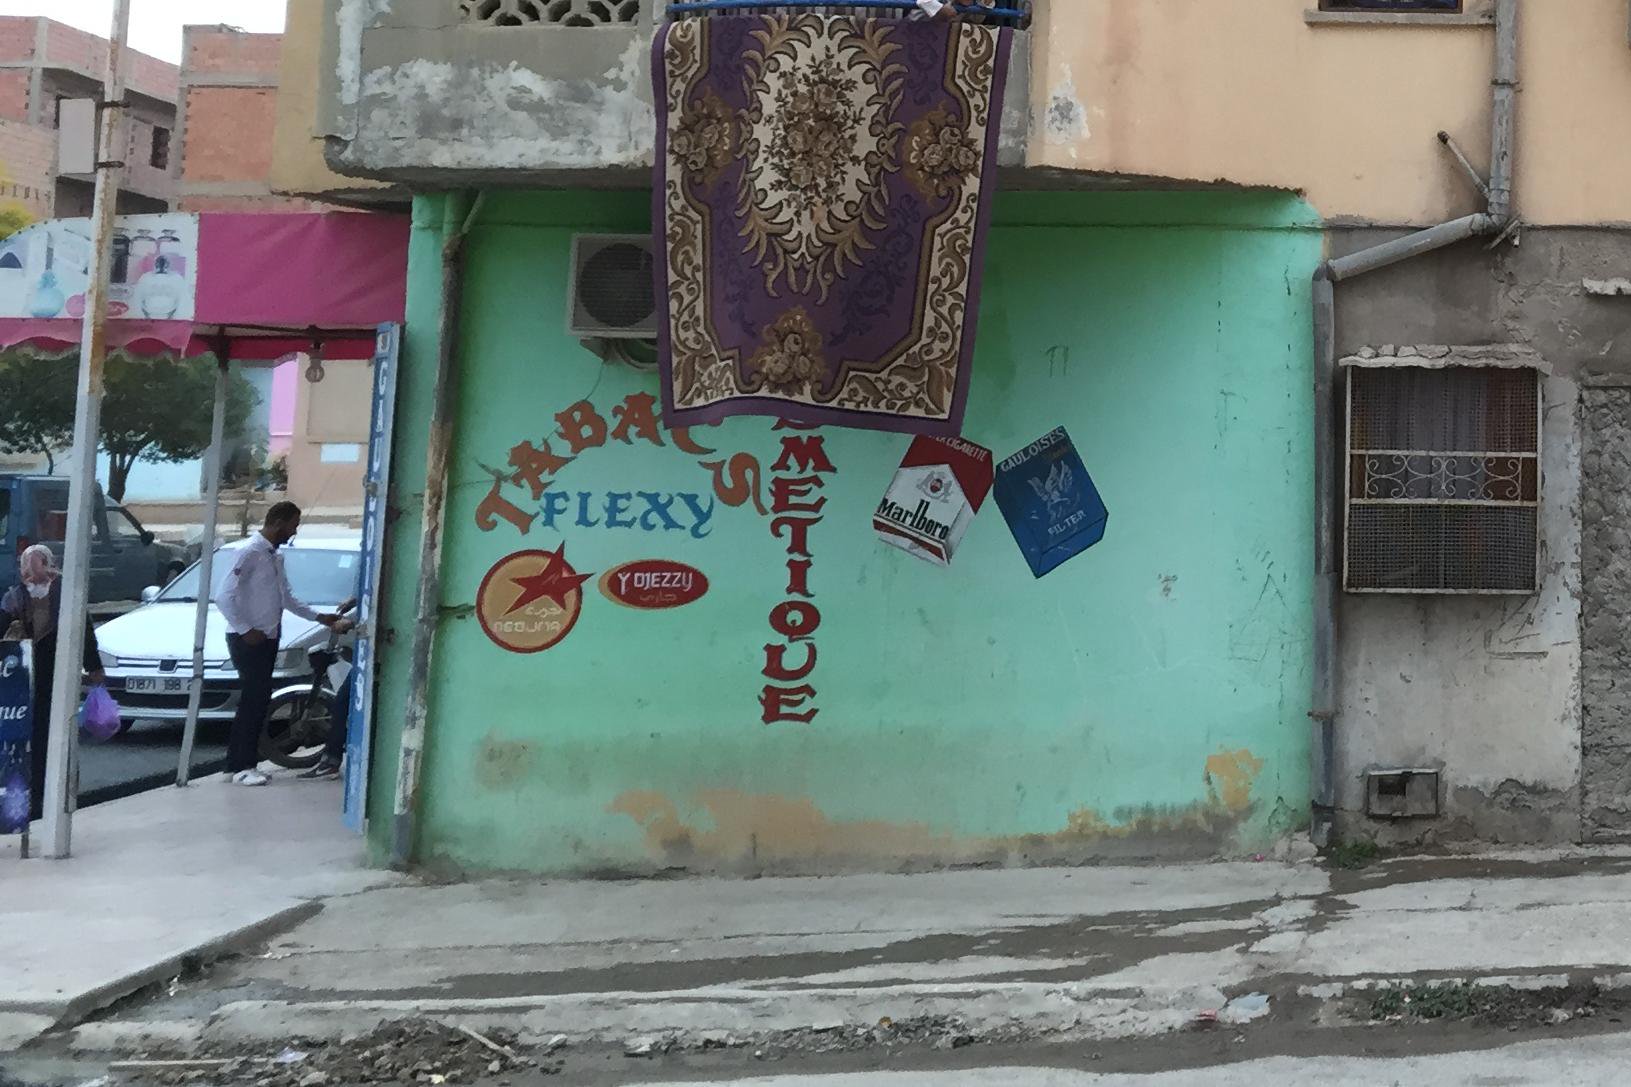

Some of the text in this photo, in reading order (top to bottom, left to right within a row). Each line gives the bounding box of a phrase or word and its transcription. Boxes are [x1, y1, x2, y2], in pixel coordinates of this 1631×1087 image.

[1001, 428, 1065, 472] GAULOISES
[541, 490, 714, 539] FLEXY
[876, 498, 950, 541] Marlboro
[1048, 510, 1087, 536] FILTER
[757, 417, 837, 725] METIQUE
